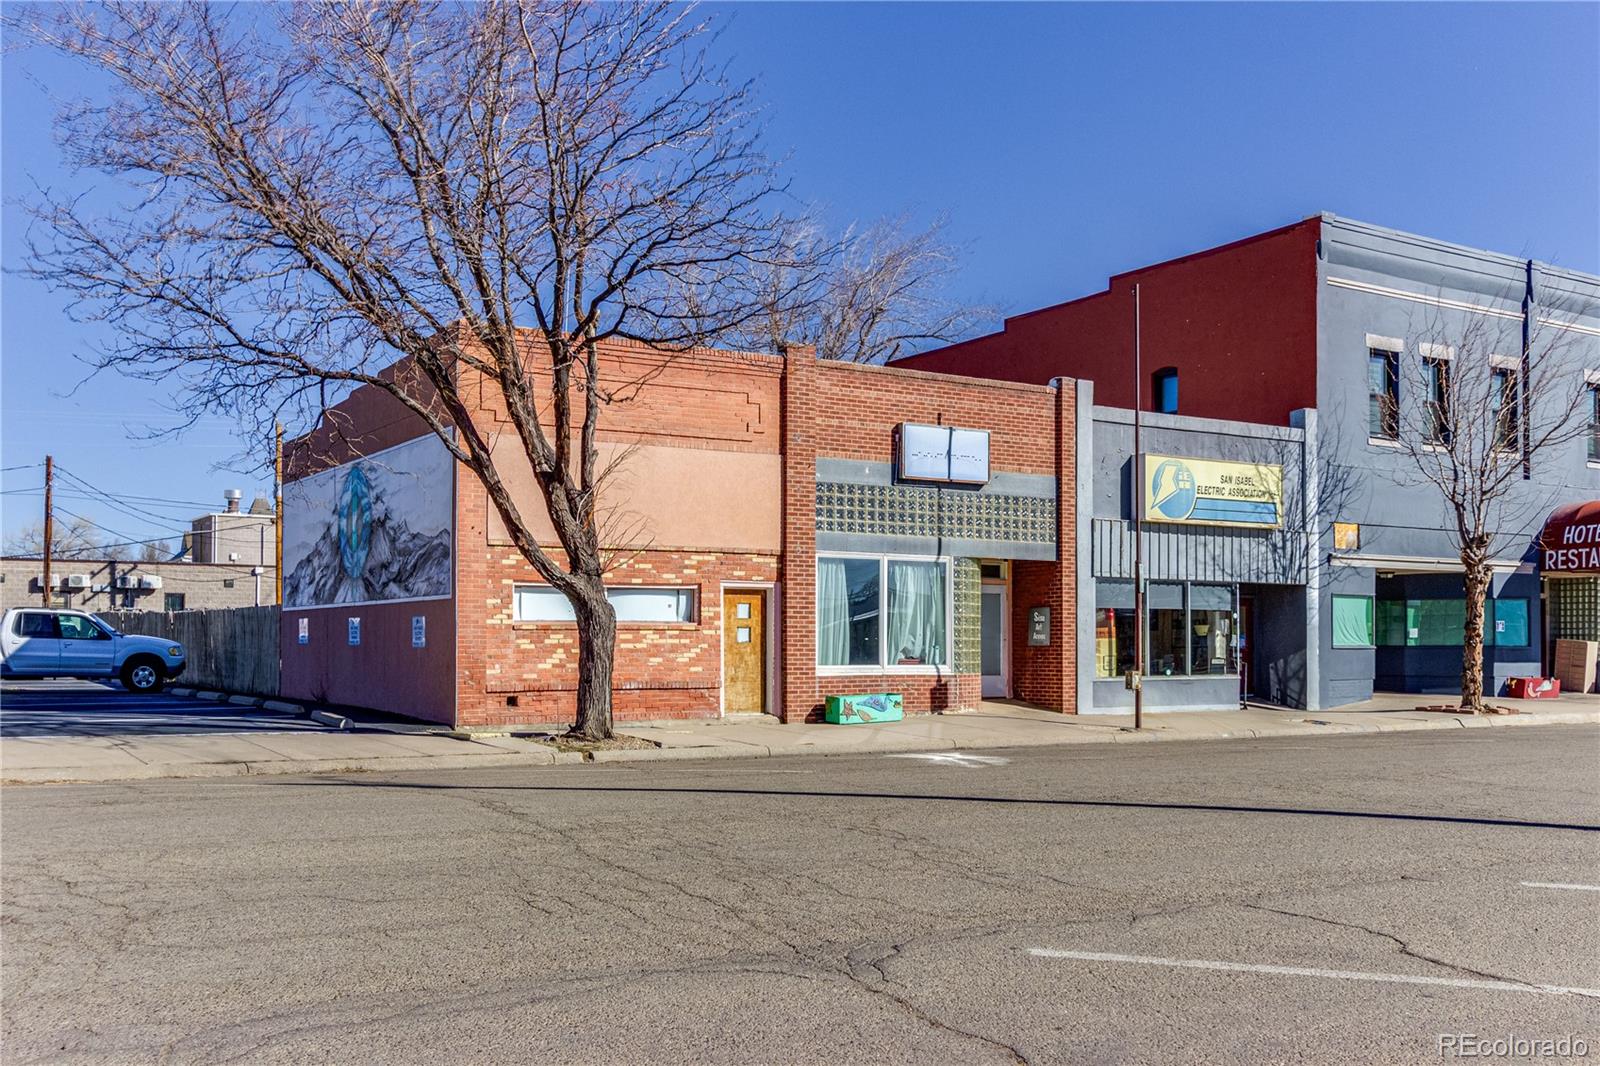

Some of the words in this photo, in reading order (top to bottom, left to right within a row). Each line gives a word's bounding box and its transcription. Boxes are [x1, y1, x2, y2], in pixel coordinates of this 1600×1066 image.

[1220, 474, 1233, 485] SAN
[1234, 476, 1255, 487] ISABEL
[1196, 485, 1226, 496] ELECTRIC
[1545, 547, 1600, 570] RESTA
